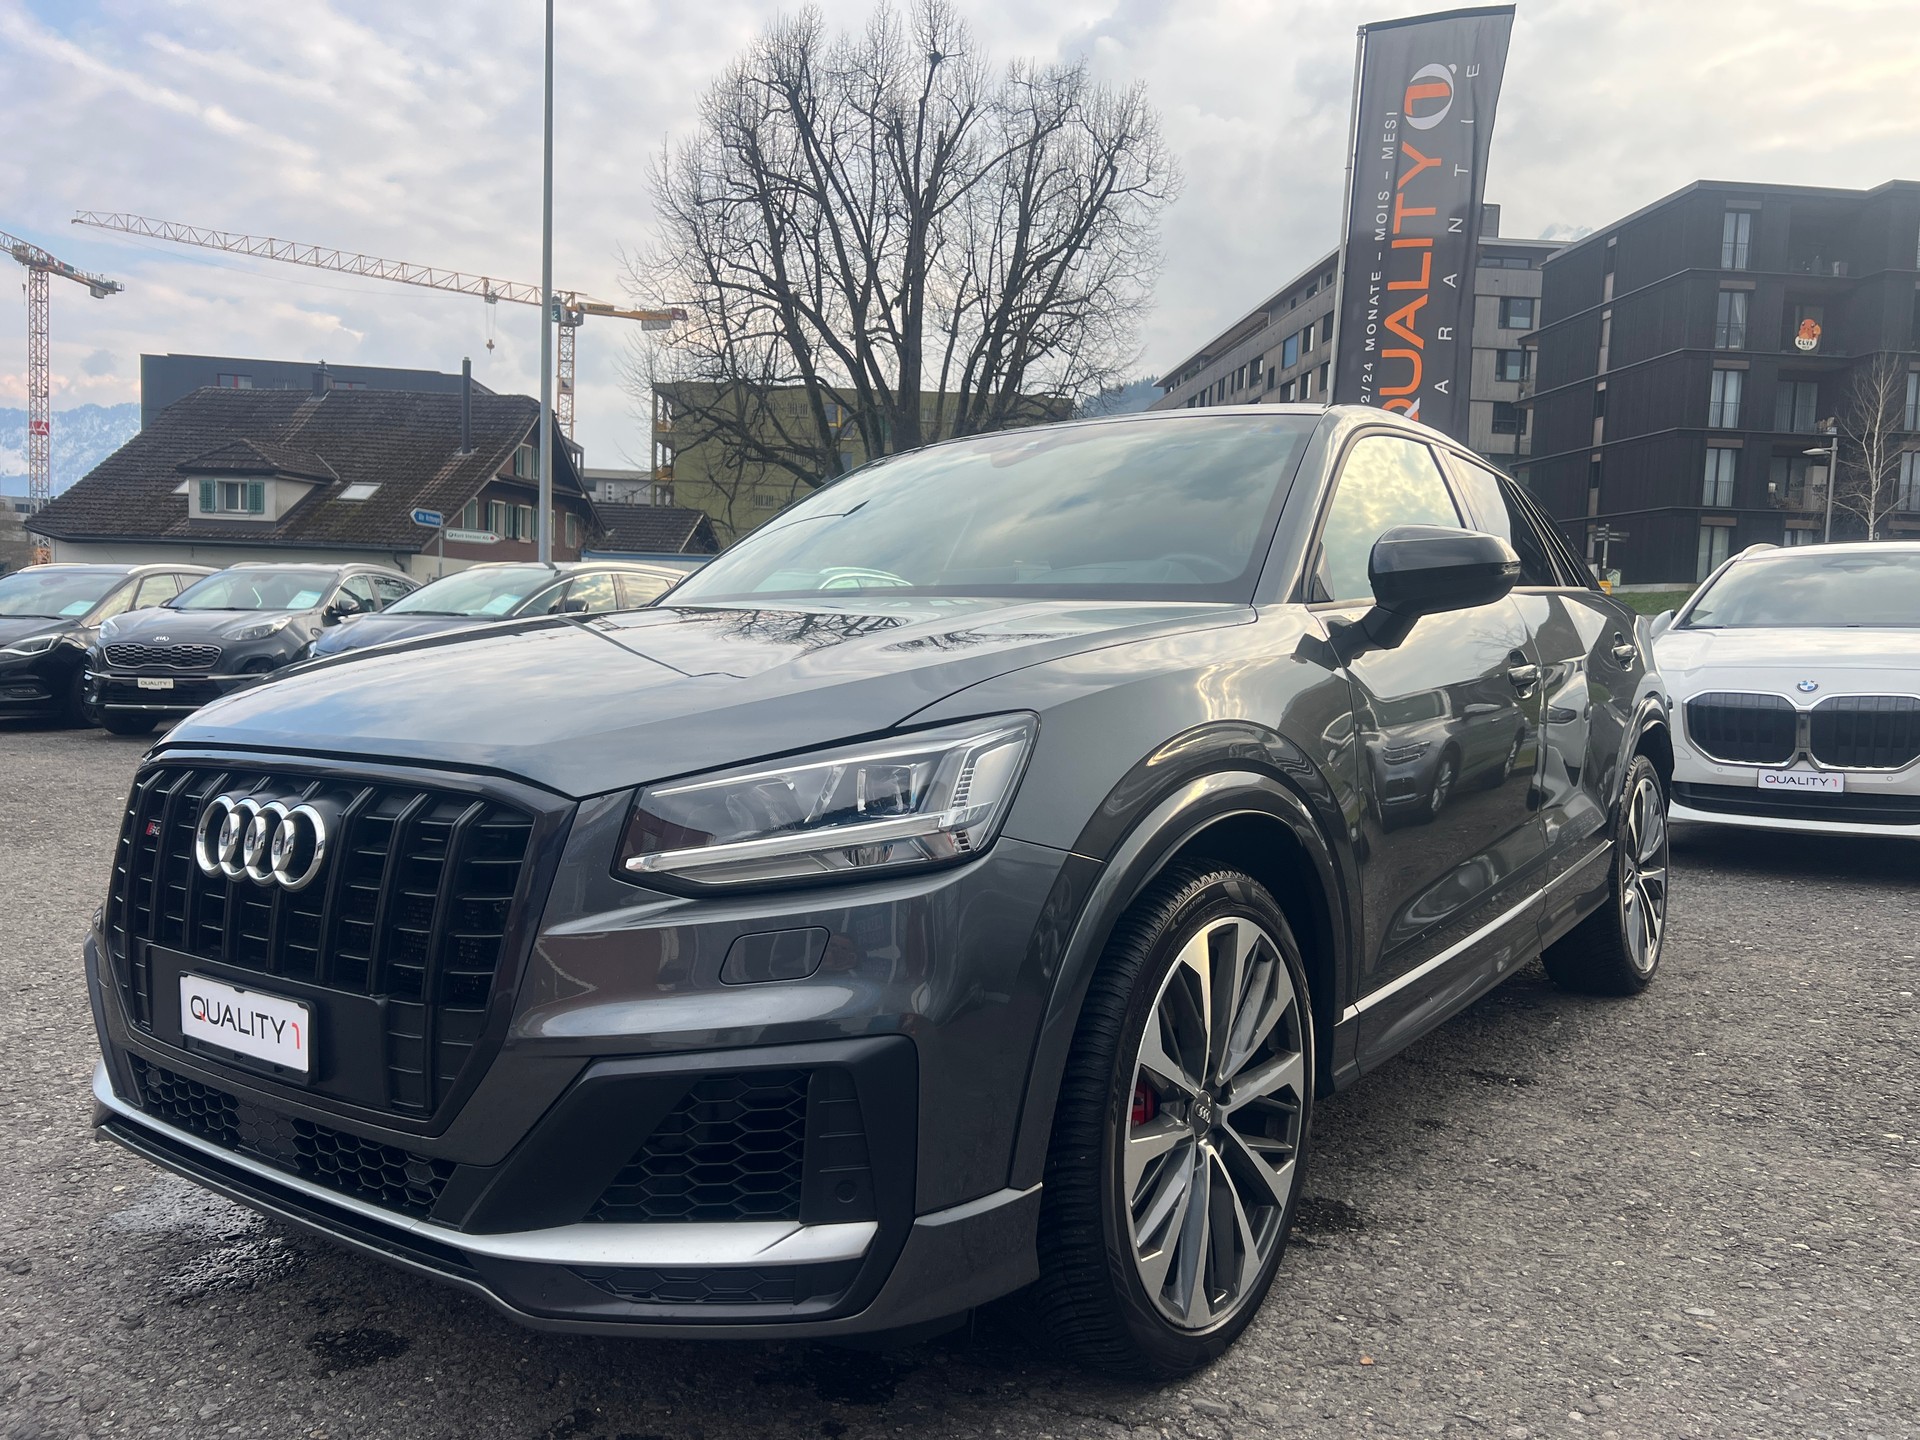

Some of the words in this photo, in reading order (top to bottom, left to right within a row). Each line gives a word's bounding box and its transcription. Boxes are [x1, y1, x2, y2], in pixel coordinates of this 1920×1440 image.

[1381, 111, 1398, 160] MESI
[1374, 190, 1390, 241] MOIS
[1434, 63, 1481, 394] ARANTIE
[1365, 271, 1382, 351] MONATE
[1360, 362, 1374, 404] 2/24
[1765, 774, 1829, 786] QUALITY
[1177, 893, 1206, 922] ROTATION
[190, 995, 286, 1044] QUALITY
[291, 1022, 300, 1050] 1
